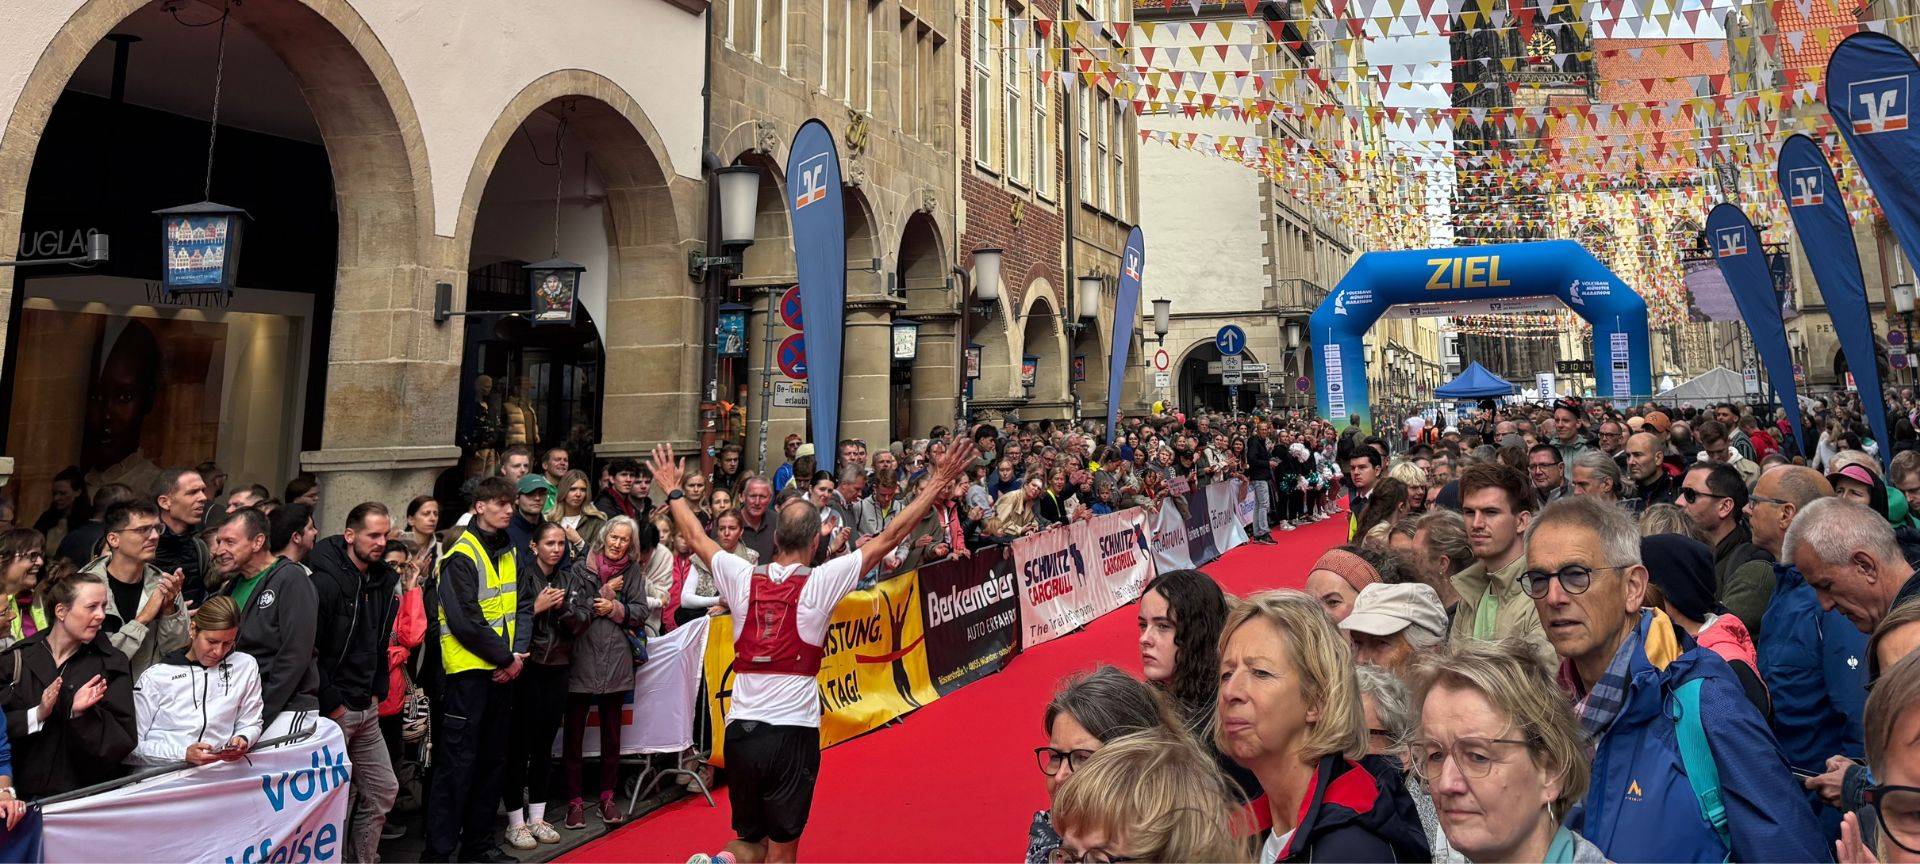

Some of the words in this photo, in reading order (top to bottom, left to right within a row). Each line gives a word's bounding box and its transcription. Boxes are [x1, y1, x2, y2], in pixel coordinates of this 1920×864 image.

[1425, 255, 1511, 290] ZIEL
[1099, 528, 1134, 560] SCHMITZ
[927, 568, 1015, 629] Berkemeier
[966, 620, 986, 642] AUTO
[1029, 623, 1049, 638] The
[826, 669, 863, 710] TAG!
